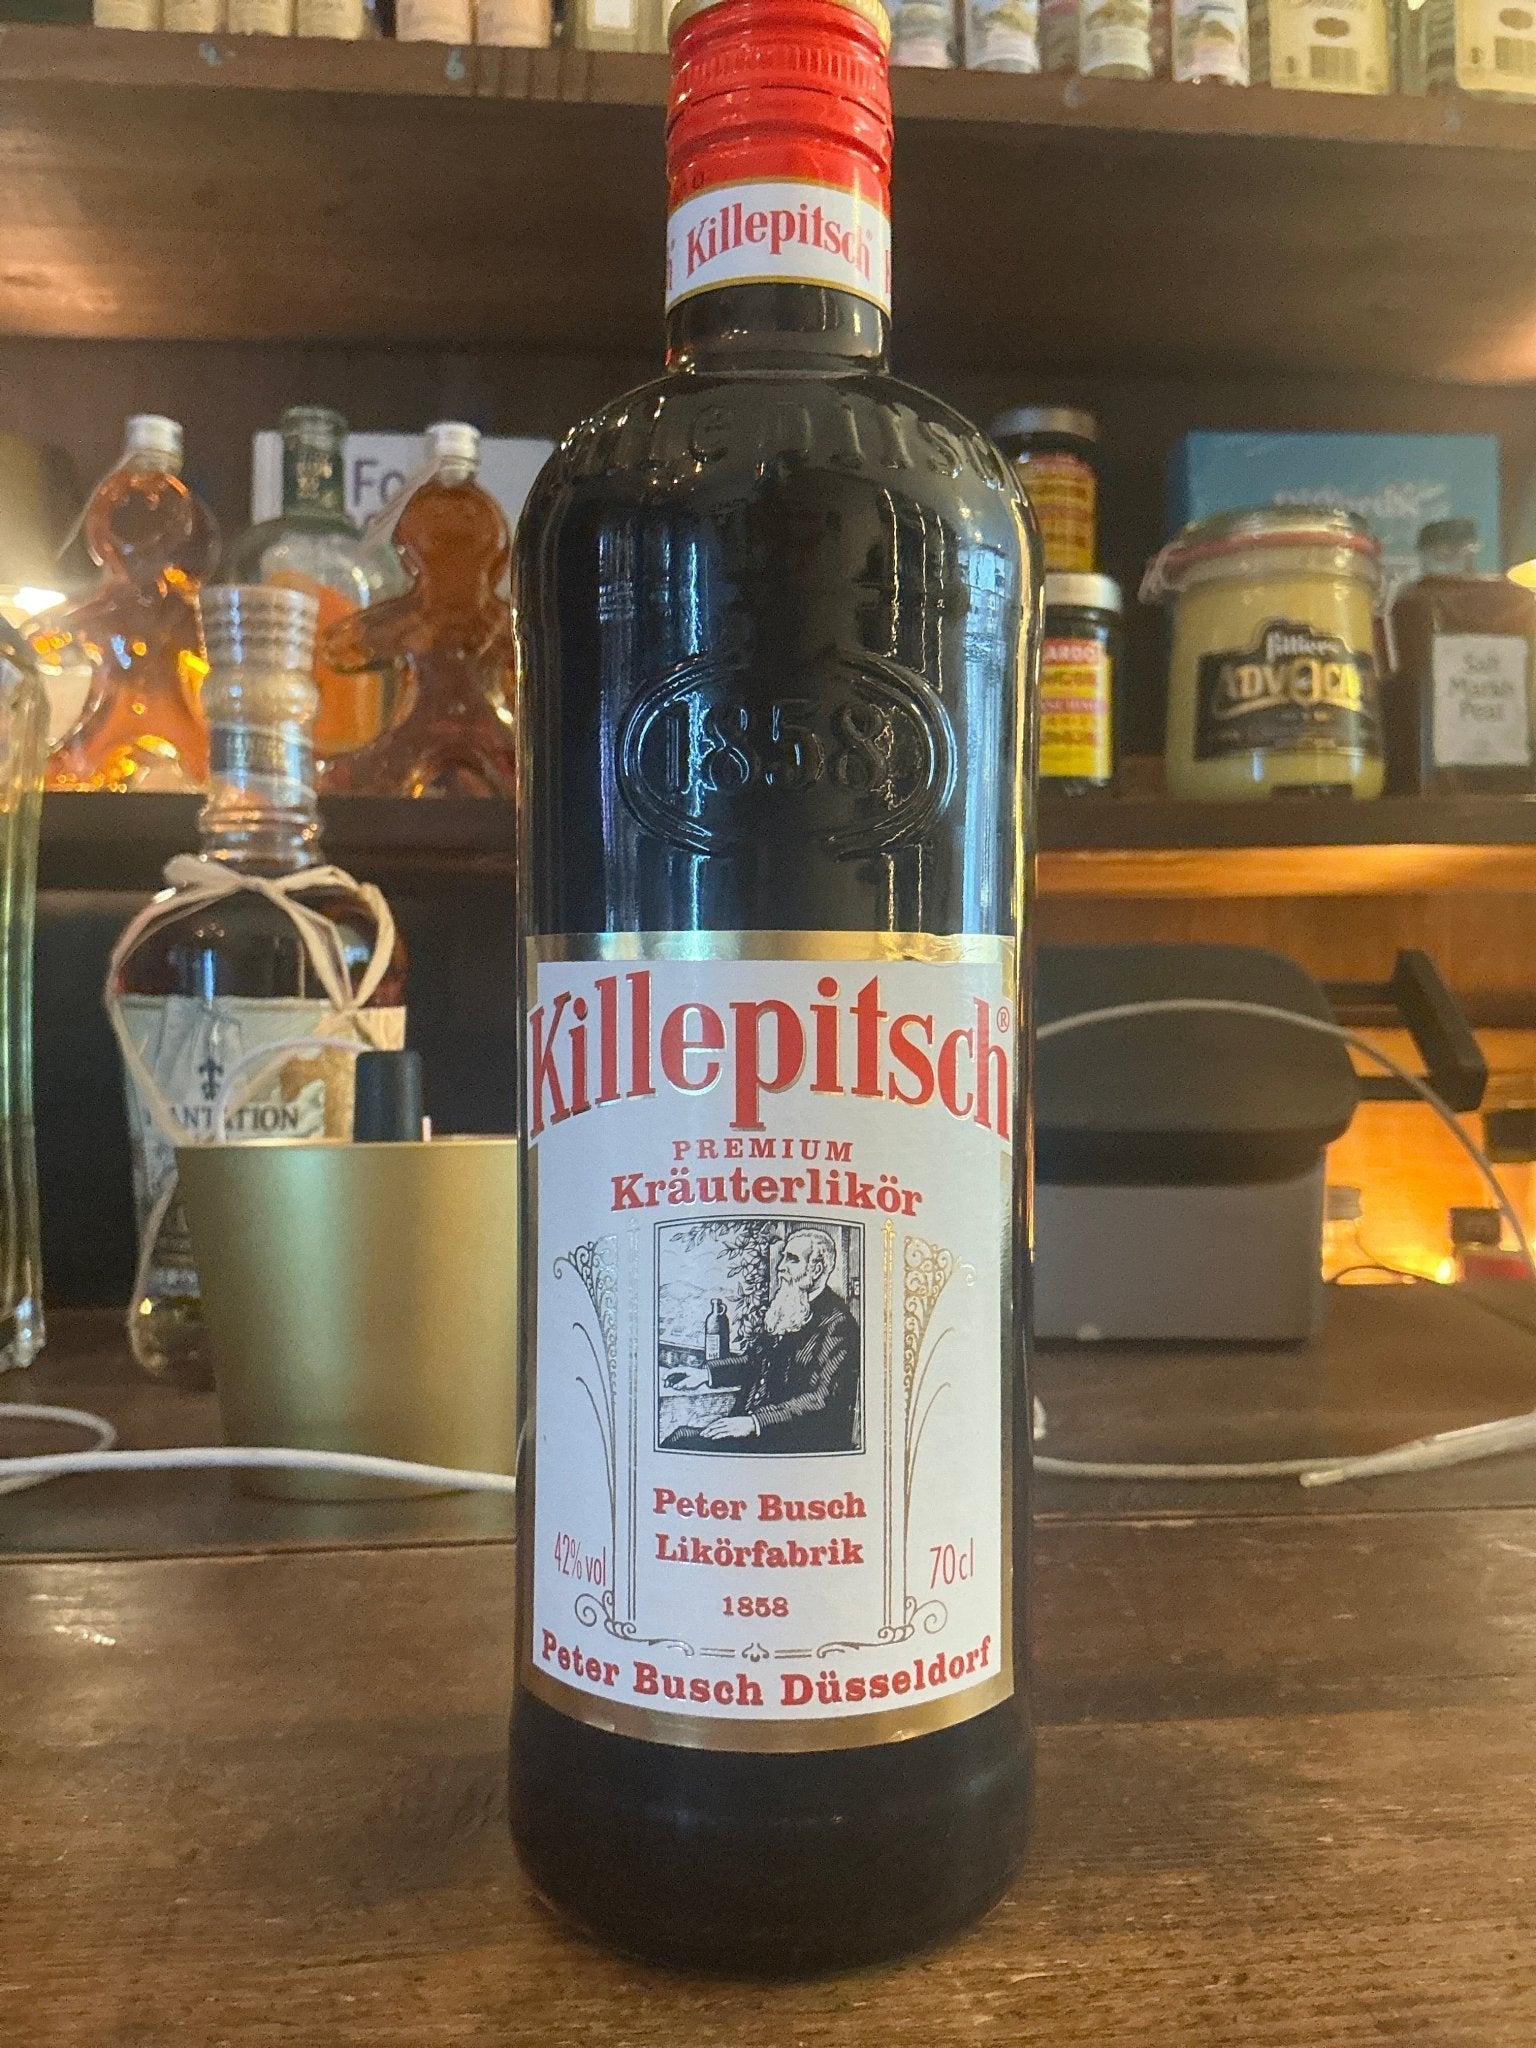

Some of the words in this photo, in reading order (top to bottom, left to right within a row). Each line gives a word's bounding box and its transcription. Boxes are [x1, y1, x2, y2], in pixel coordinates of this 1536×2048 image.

[672, 1138, 854, 1163] PREMIUM
[610, 1167, 922, 1217] Kräuterlikör
[652, 1487, 747, 1520] Peter
[757, 1492, 866, 1522] Busch
[655, 1533, 864, 1568] Likörfabrik
[722, 1597, 789, 1618] 1858
[541, 1628, 619, 1688] Peter
[633, 1662, 763, 1706] Busch
[780, 1635, 992, 1706] Düsseldorf
